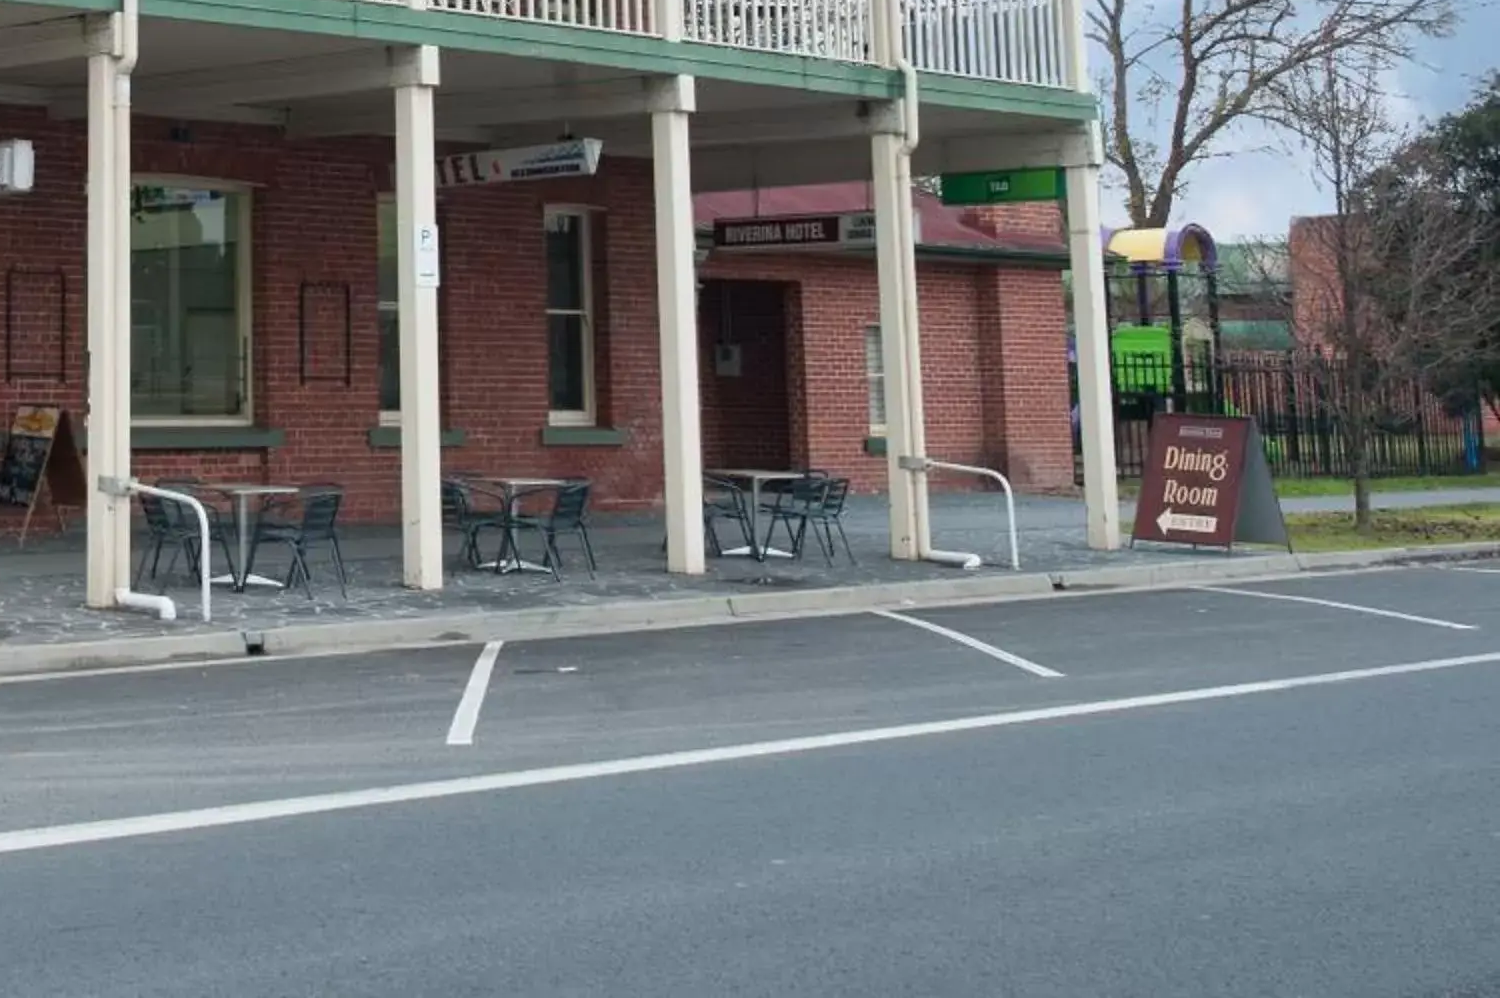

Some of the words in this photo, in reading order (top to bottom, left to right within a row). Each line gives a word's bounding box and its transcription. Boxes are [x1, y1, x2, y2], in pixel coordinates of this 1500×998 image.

[724, 224, 782, 244] RIVERINA
[784, 222, 825, 240] HOTEL
[1163, 445, 1229, 481] Dining
[1163, 479, 1218, 507] Room
